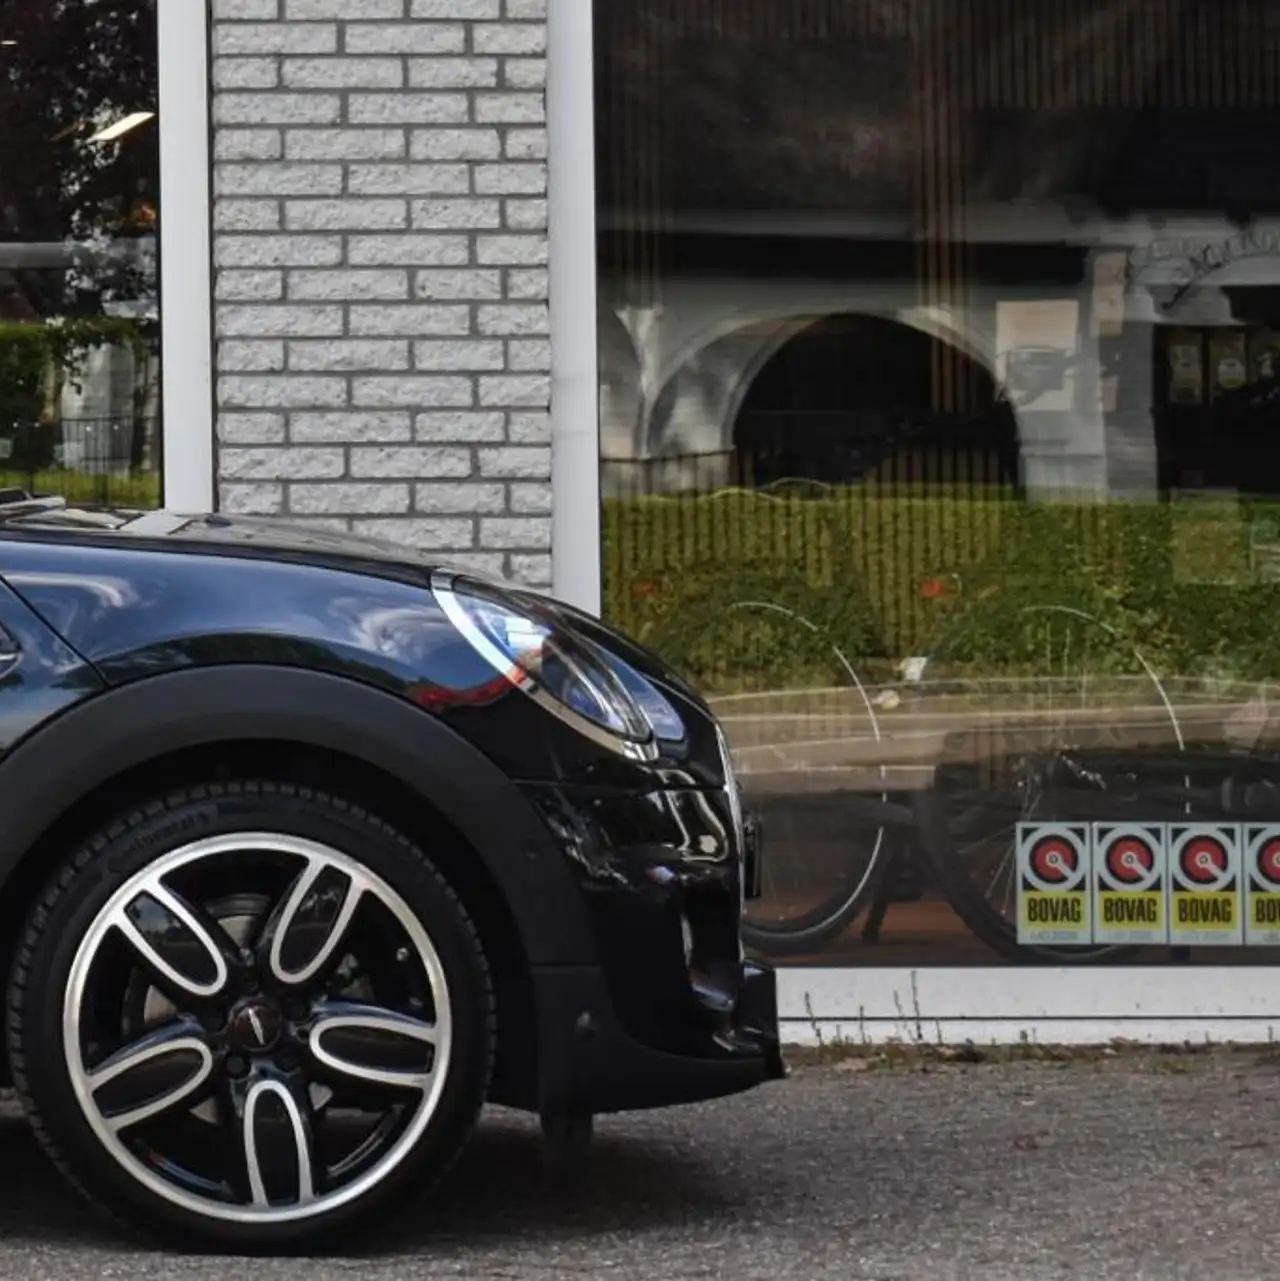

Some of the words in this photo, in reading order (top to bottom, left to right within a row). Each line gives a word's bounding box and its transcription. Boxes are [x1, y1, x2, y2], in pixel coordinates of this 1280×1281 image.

[1027, 898, 1081, 922] BOVAG
[1103, 898, 1157, 922] BOVAG
[1178, 898, 1232, 922] BOVAG
